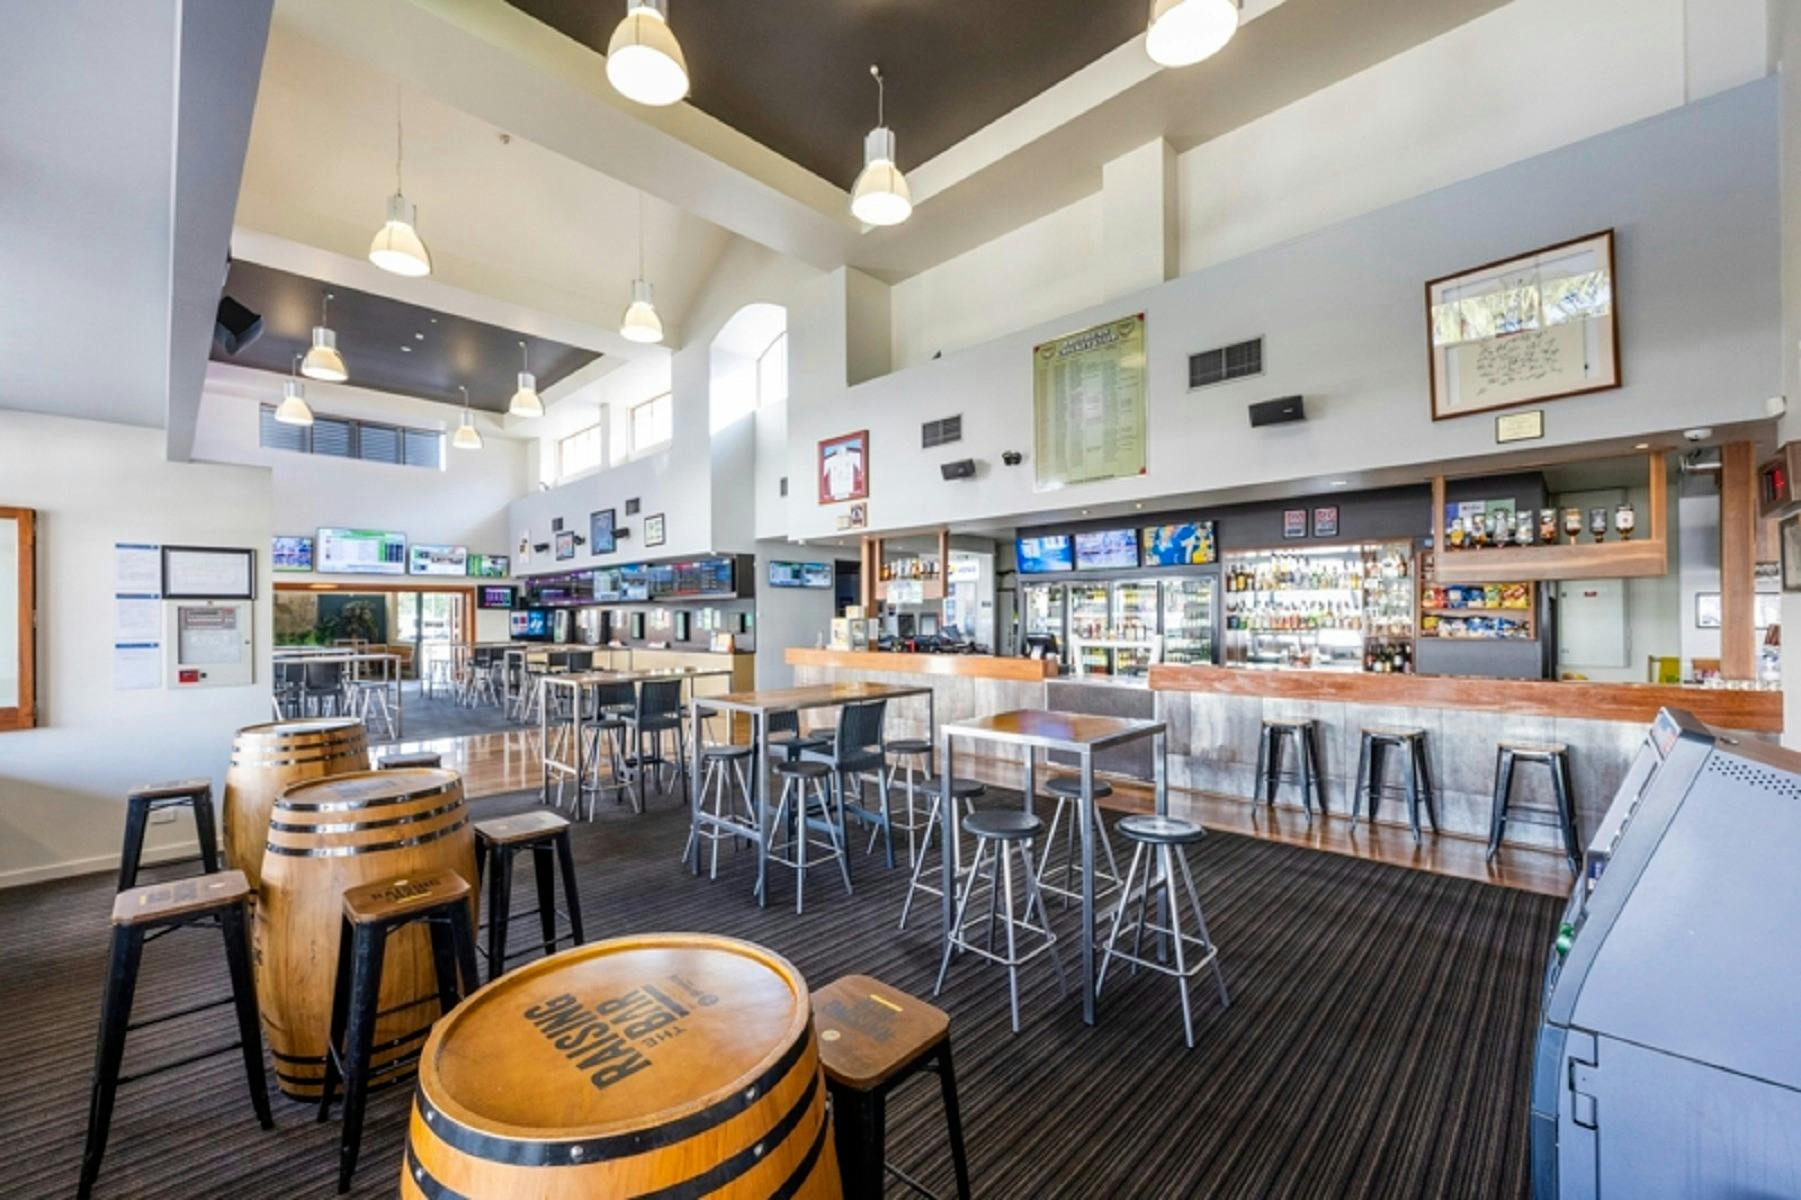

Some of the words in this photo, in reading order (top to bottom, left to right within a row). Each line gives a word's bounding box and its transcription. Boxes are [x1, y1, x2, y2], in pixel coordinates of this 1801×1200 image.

[596, 989, 678, 1041] BAR
[641, 1025, 688, 1048] THE
[523, 993, 653, 1090] RAISING
